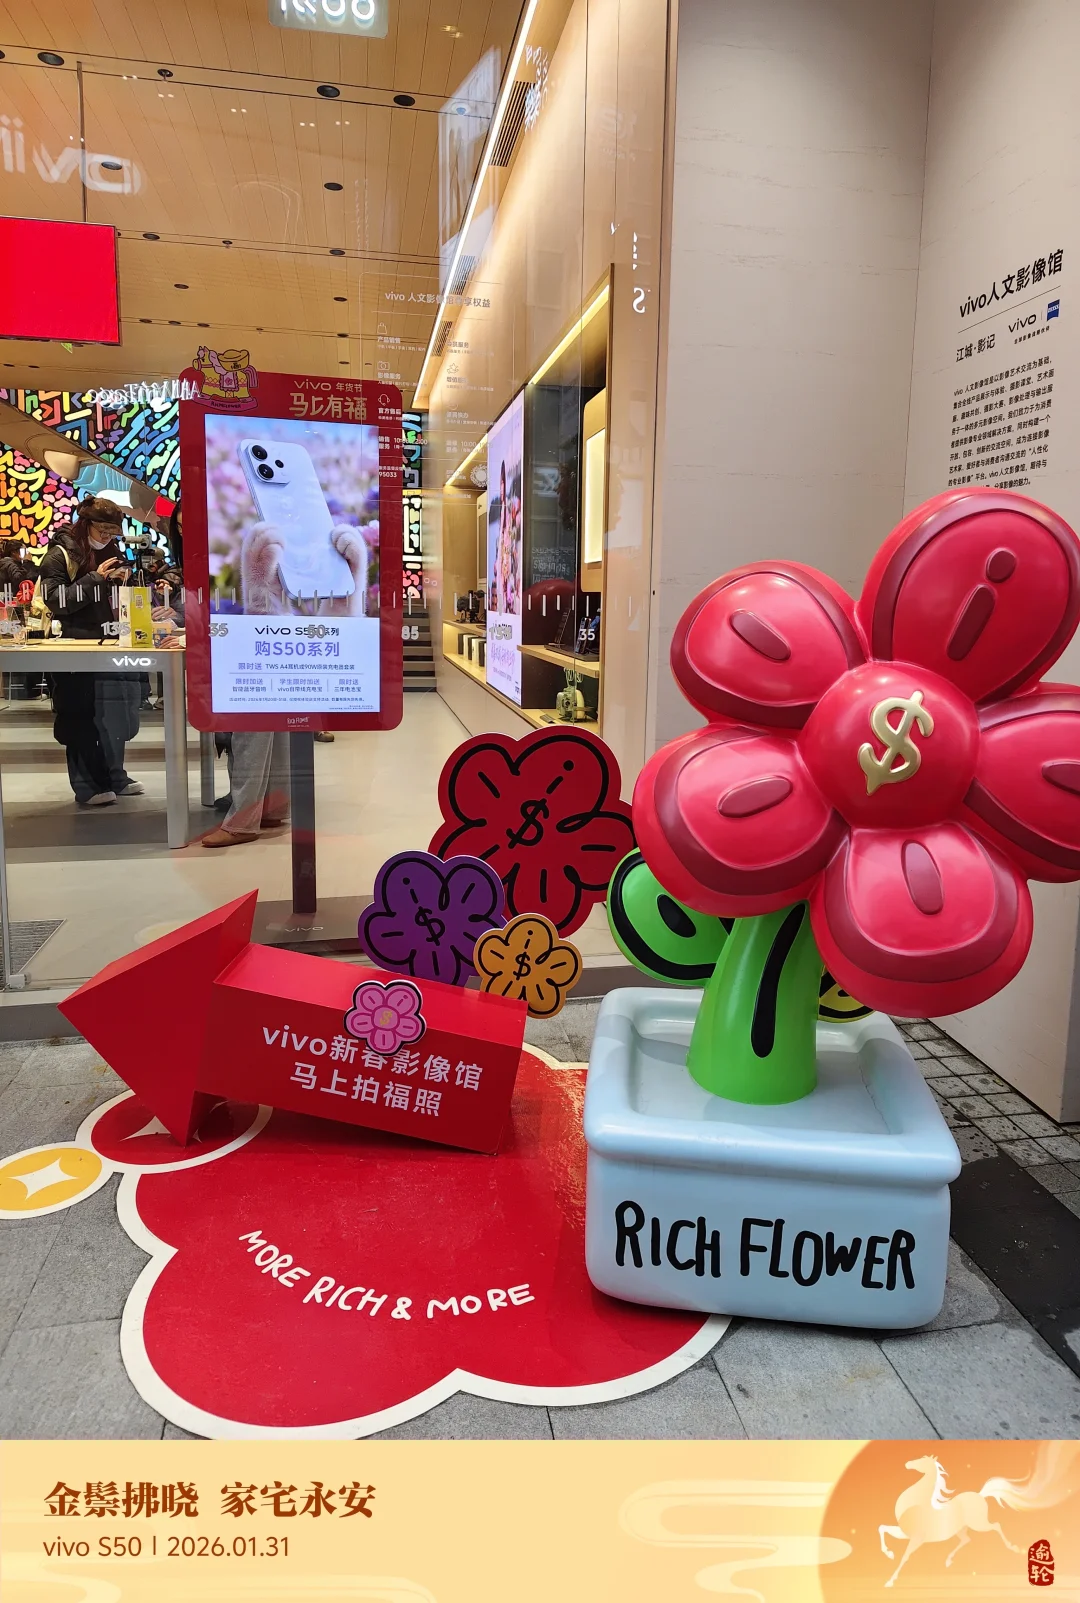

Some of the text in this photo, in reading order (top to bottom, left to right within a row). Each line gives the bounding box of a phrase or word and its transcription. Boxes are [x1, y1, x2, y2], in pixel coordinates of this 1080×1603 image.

[959, 248, 1064, 318] vivo人文影像馆
[385, 291, 405, 302] vivo
[1008, 313, 1037, 333] vivo
[293, 378, 332, 391] vivo
[336, 382, 363, 393] 年货节
[254, 624, 291, 635] vivo
[401, 625, 420, 640] 85
[579, 628, 596, 641] 35
[254, 640, 340, 657] 购S50系列
[112, 655, 151, 667] vivo
[238, 662, 262, 671] 限时送
[235, 678, 264, 686] 限时加送
[279, 678, 321, 686] 学生限时加送
[338, 678, 359, 686] 限时送
[290, 1061, 443, 1117] 马上拍福照
[615, 1200, 916, 1291] RICH FLOWER
[238, 1230, 536, 1320] MORE RICH & MORE
